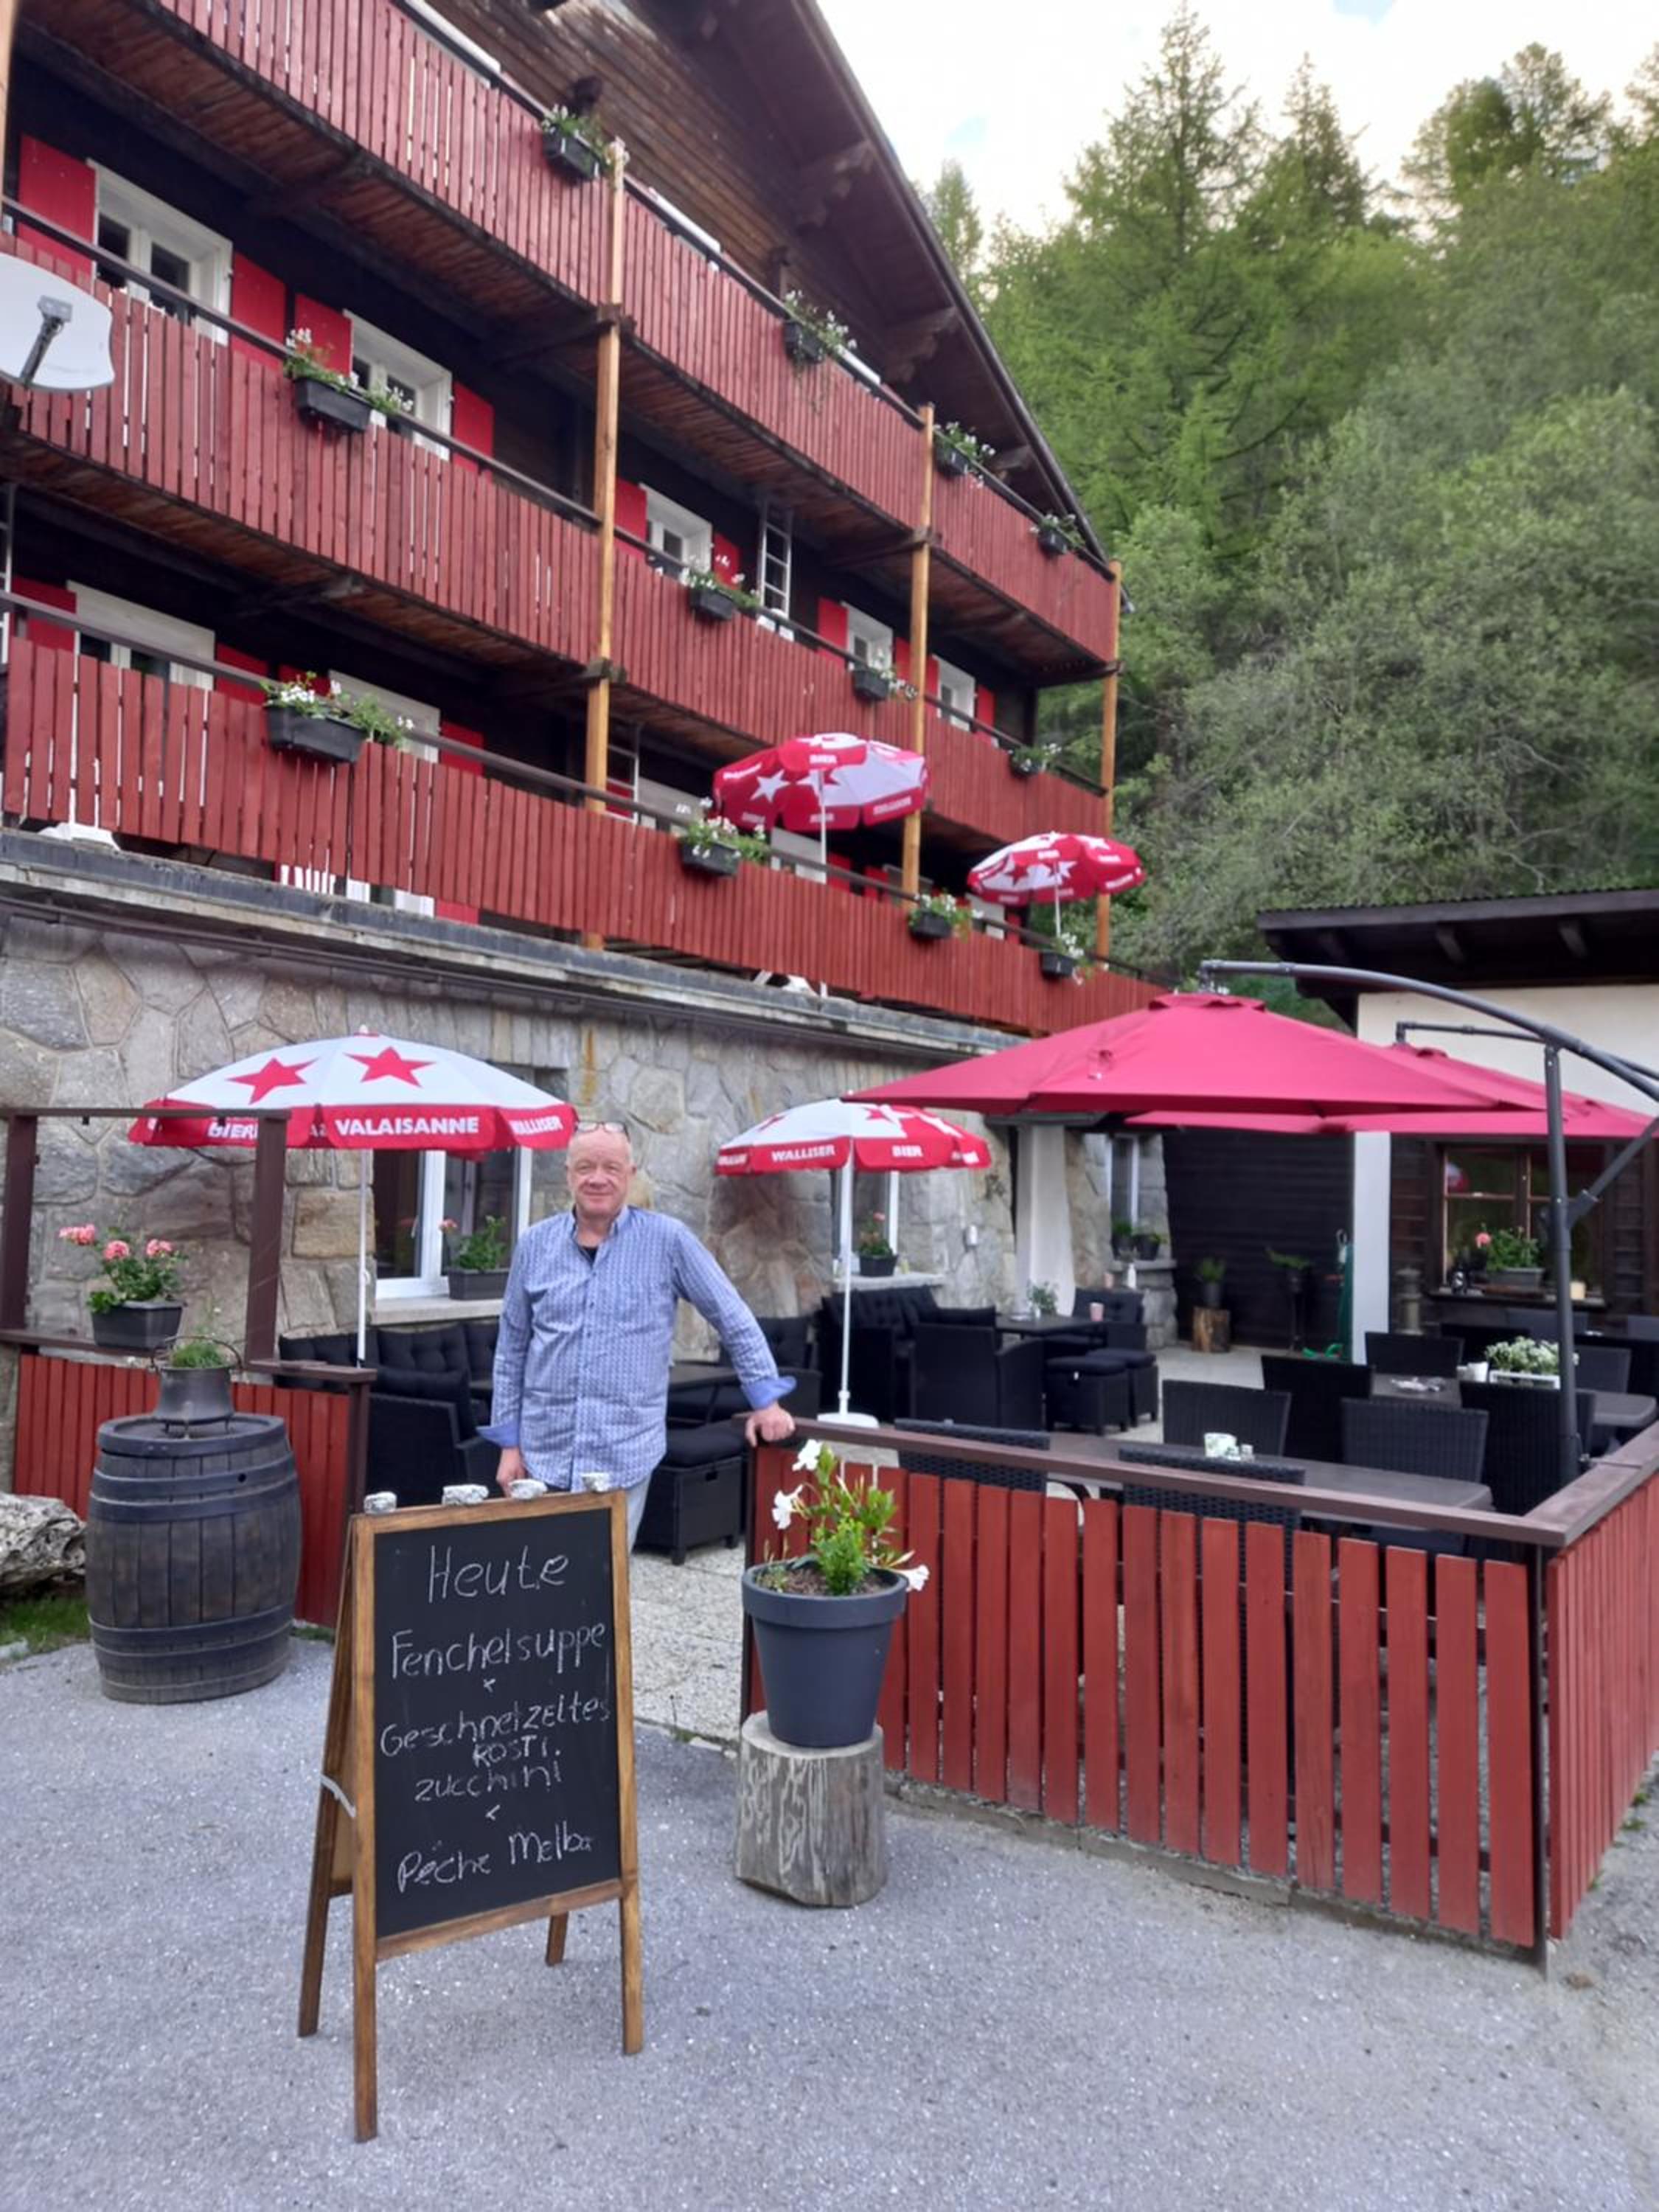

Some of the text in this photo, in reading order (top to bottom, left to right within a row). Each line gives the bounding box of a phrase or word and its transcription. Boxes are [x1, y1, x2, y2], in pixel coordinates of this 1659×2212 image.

[207, 1120, 258, 1138] BIER
[335, 1116, 479, 1135] VALAISANNE
[771, 1144, 835, 1163] WALLISER
[891, 1144, 923, 1158] BIER
[428, 1545, 569, 1604] Heute
[391, 1623, 605, 1679] Fenchelsuppe
